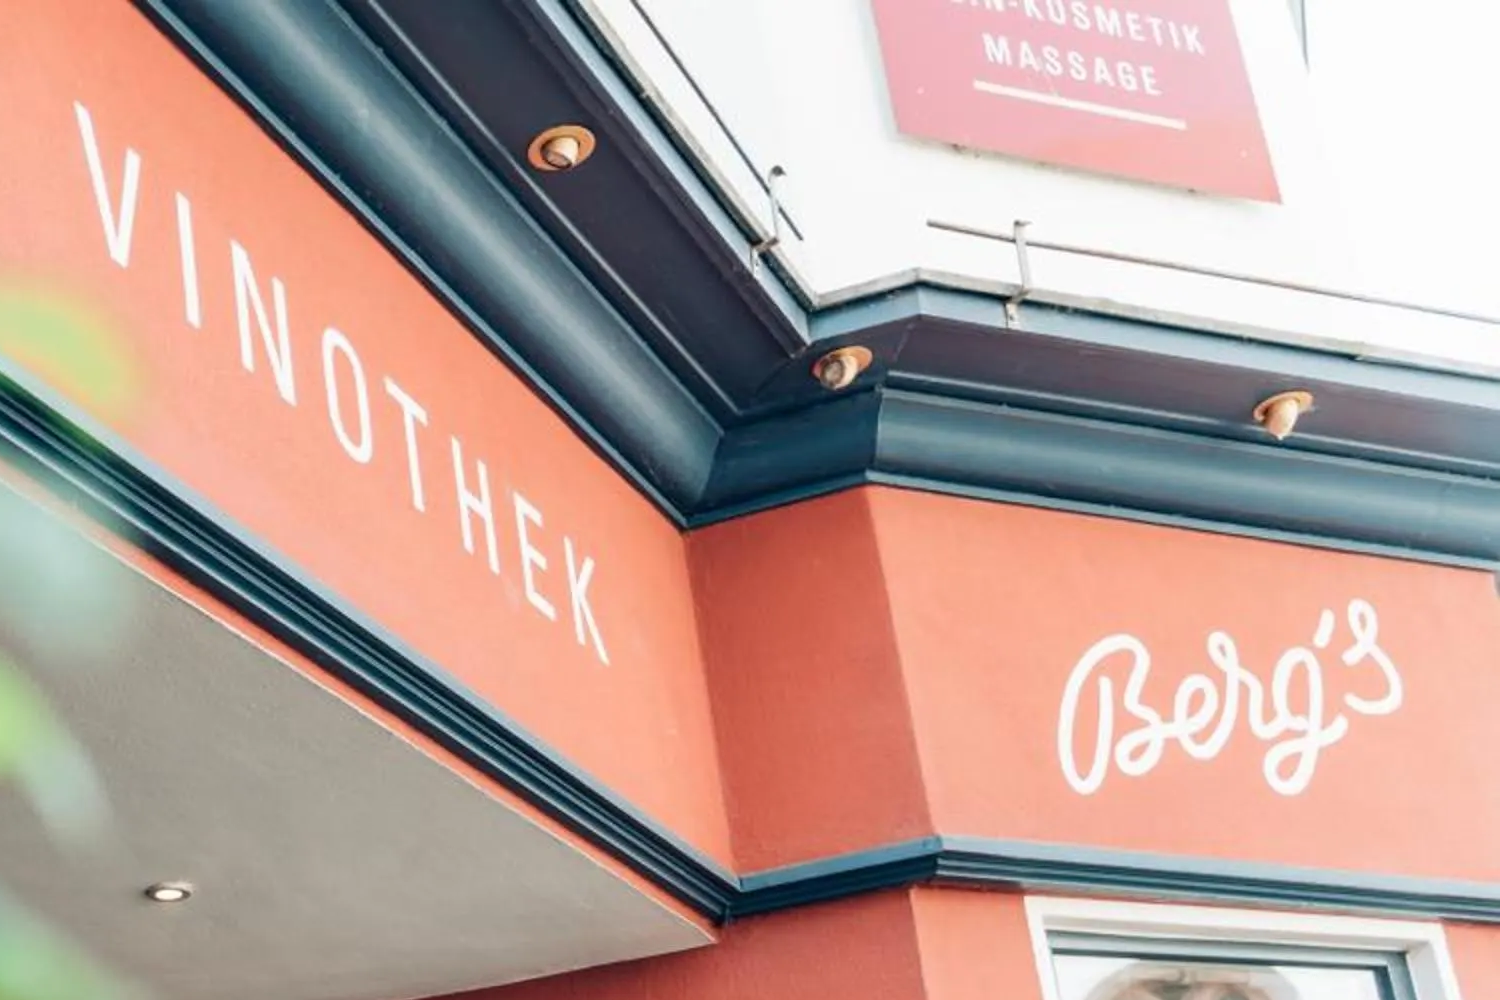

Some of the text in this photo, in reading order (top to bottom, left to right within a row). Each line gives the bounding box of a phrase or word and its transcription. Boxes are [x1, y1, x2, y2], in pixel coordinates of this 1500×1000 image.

[950, 0, 1204, 54] -KOSMETIK
[982, 32, 1163, 96] MASSAGE
[74, 100, 610, 666] VINOTHEK
